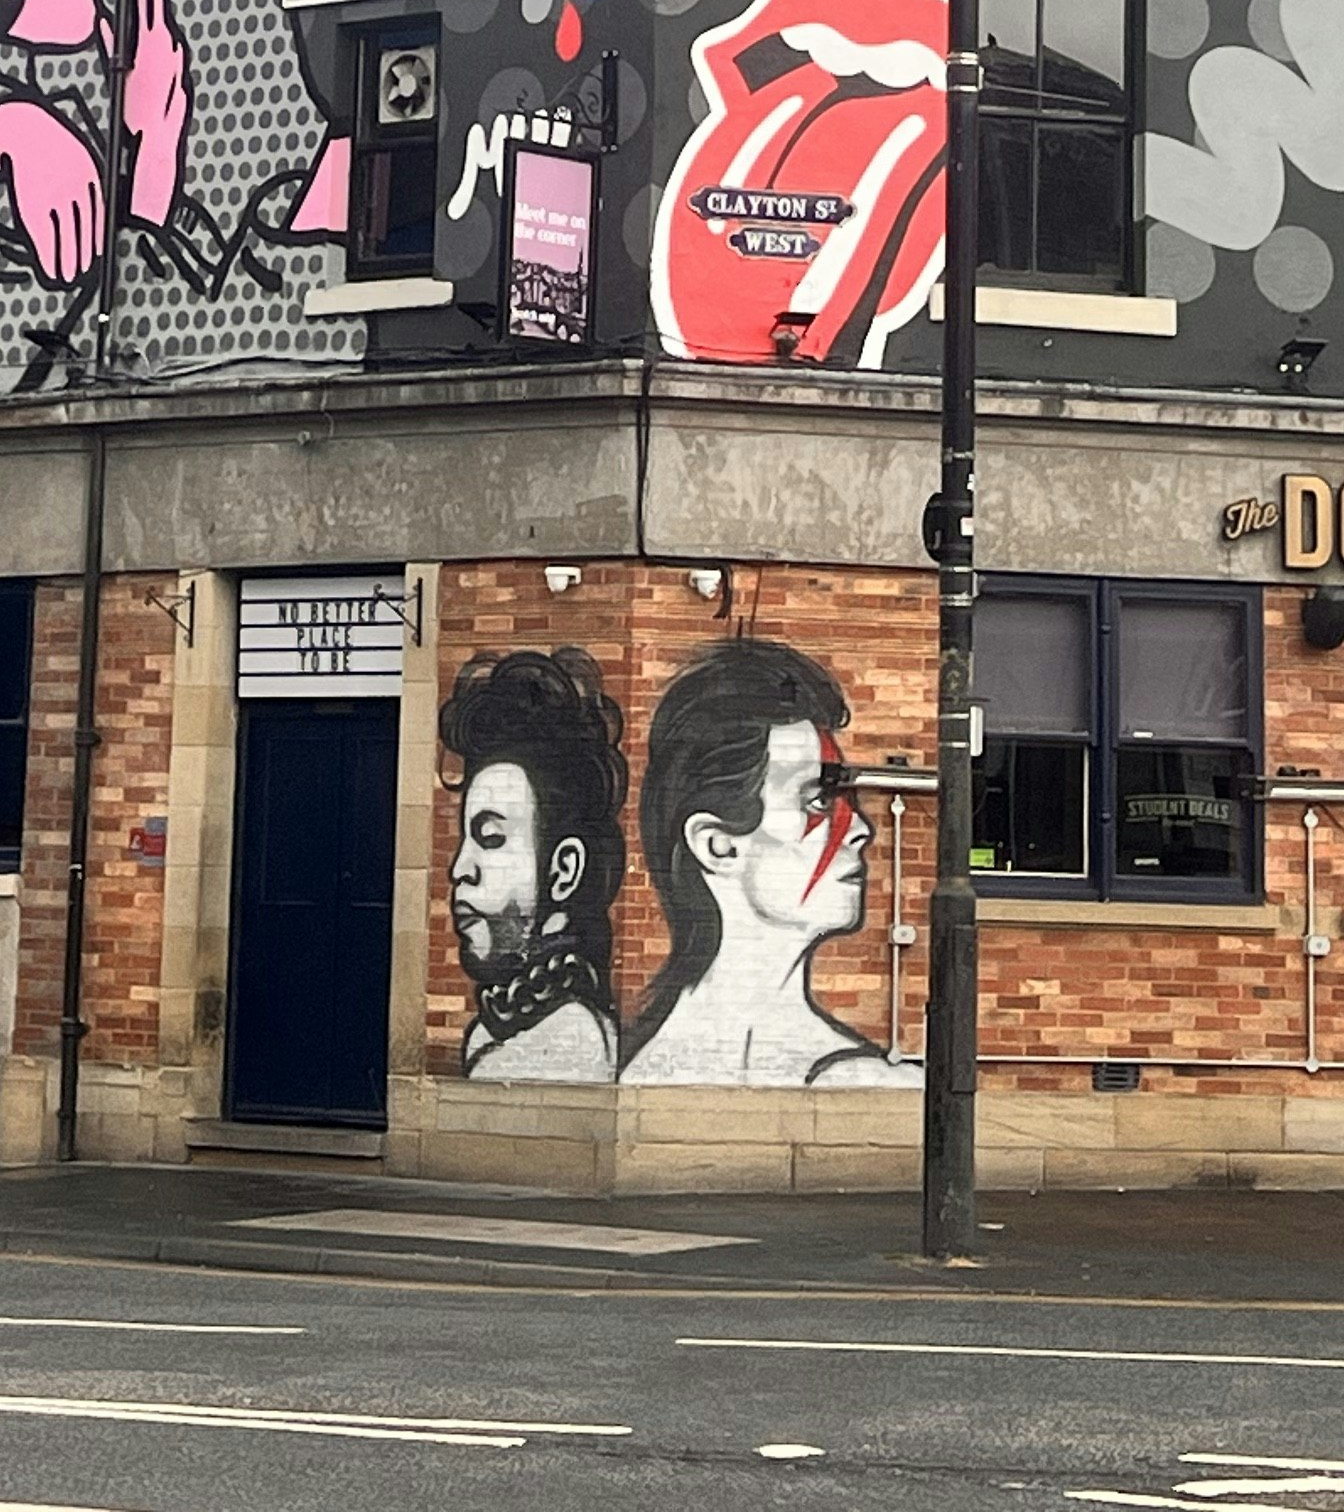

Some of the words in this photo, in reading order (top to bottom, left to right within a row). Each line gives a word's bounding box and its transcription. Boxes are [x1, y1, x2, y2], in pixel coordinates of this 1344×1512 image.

[706, 192, 808, 219] CLAYTON
[548, 211, 568, 227] me
[570, 215, 587, 230] on
[514, 221, 536, 240] the
[536, 228, 577, 248] corner
[743, 230, 807, 255] WEST
[1224, 497, 1280, 540] The
[278, 601, 299, 623] NO
[311, 601, 376, 623] BETTER
[297, 625, 354, 648] PLACE
[298, 650, 320, 672] TO
[331, 650, 351, 672] BE
[1188, 800, 1230, 820] DEALS
